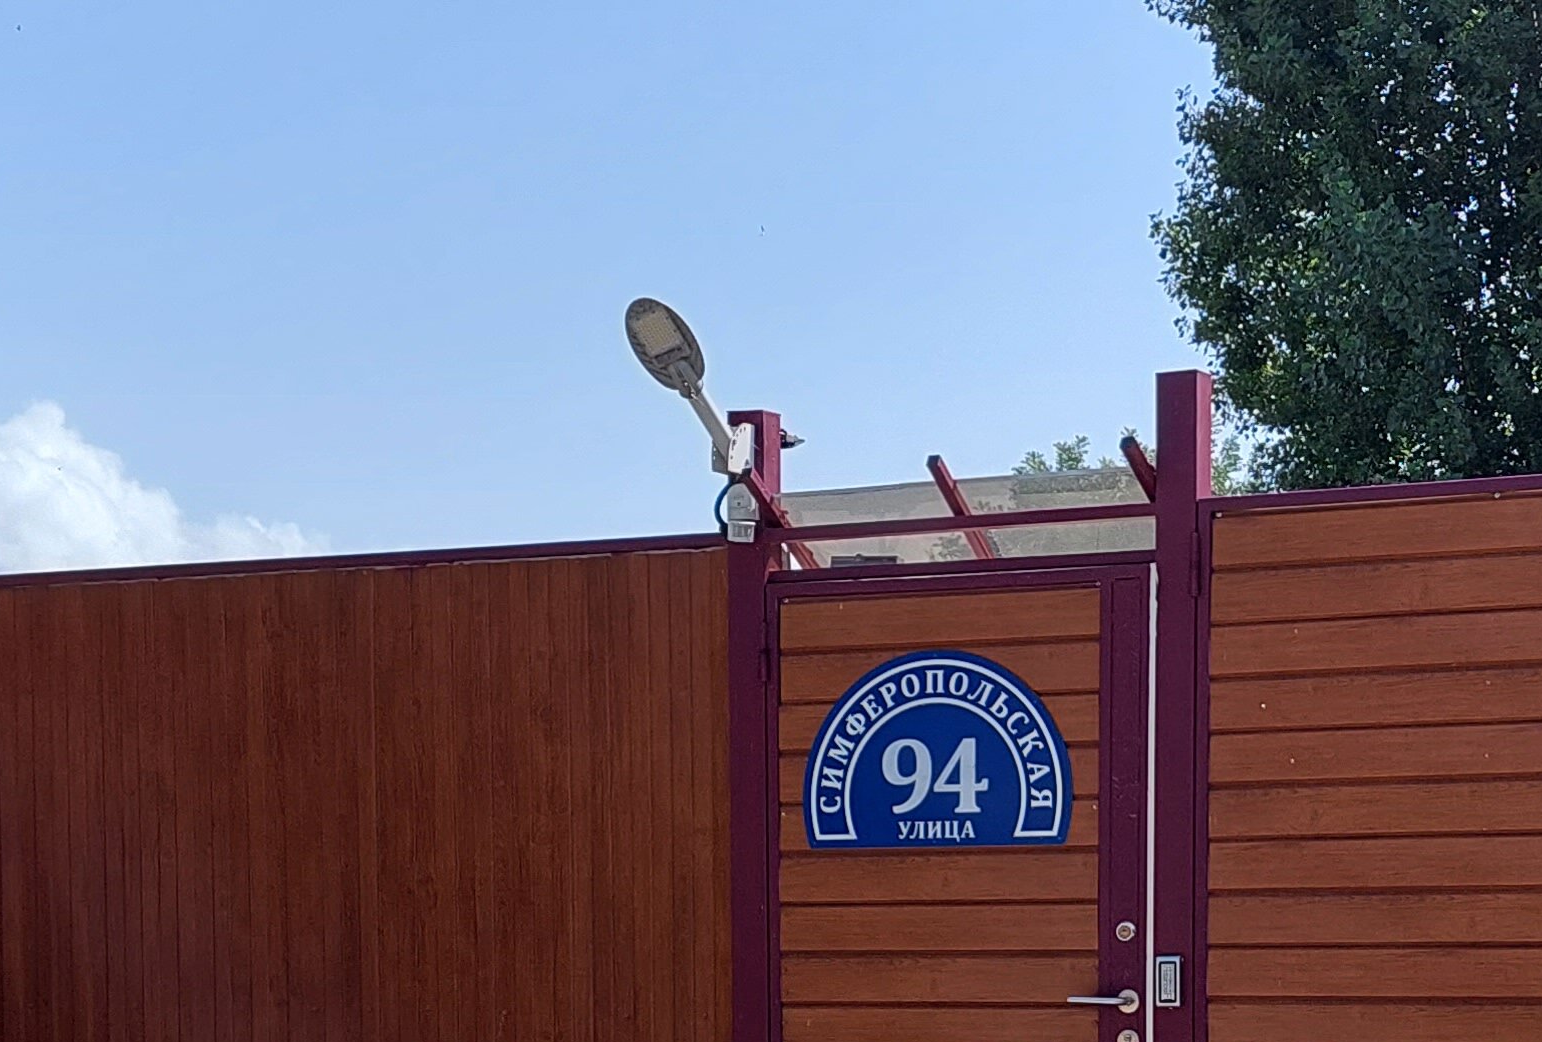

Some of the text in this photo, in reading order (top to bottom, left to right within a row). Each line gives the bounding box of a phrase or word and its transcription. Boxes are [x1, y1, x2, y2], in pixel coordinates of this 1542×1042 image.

[819, 669, 1053, 814] СИМФЕРОПОЛЬСКАЯ
[881, 737, 989, 815] 94
[897, 820, 976, 842] УЛИЦА
